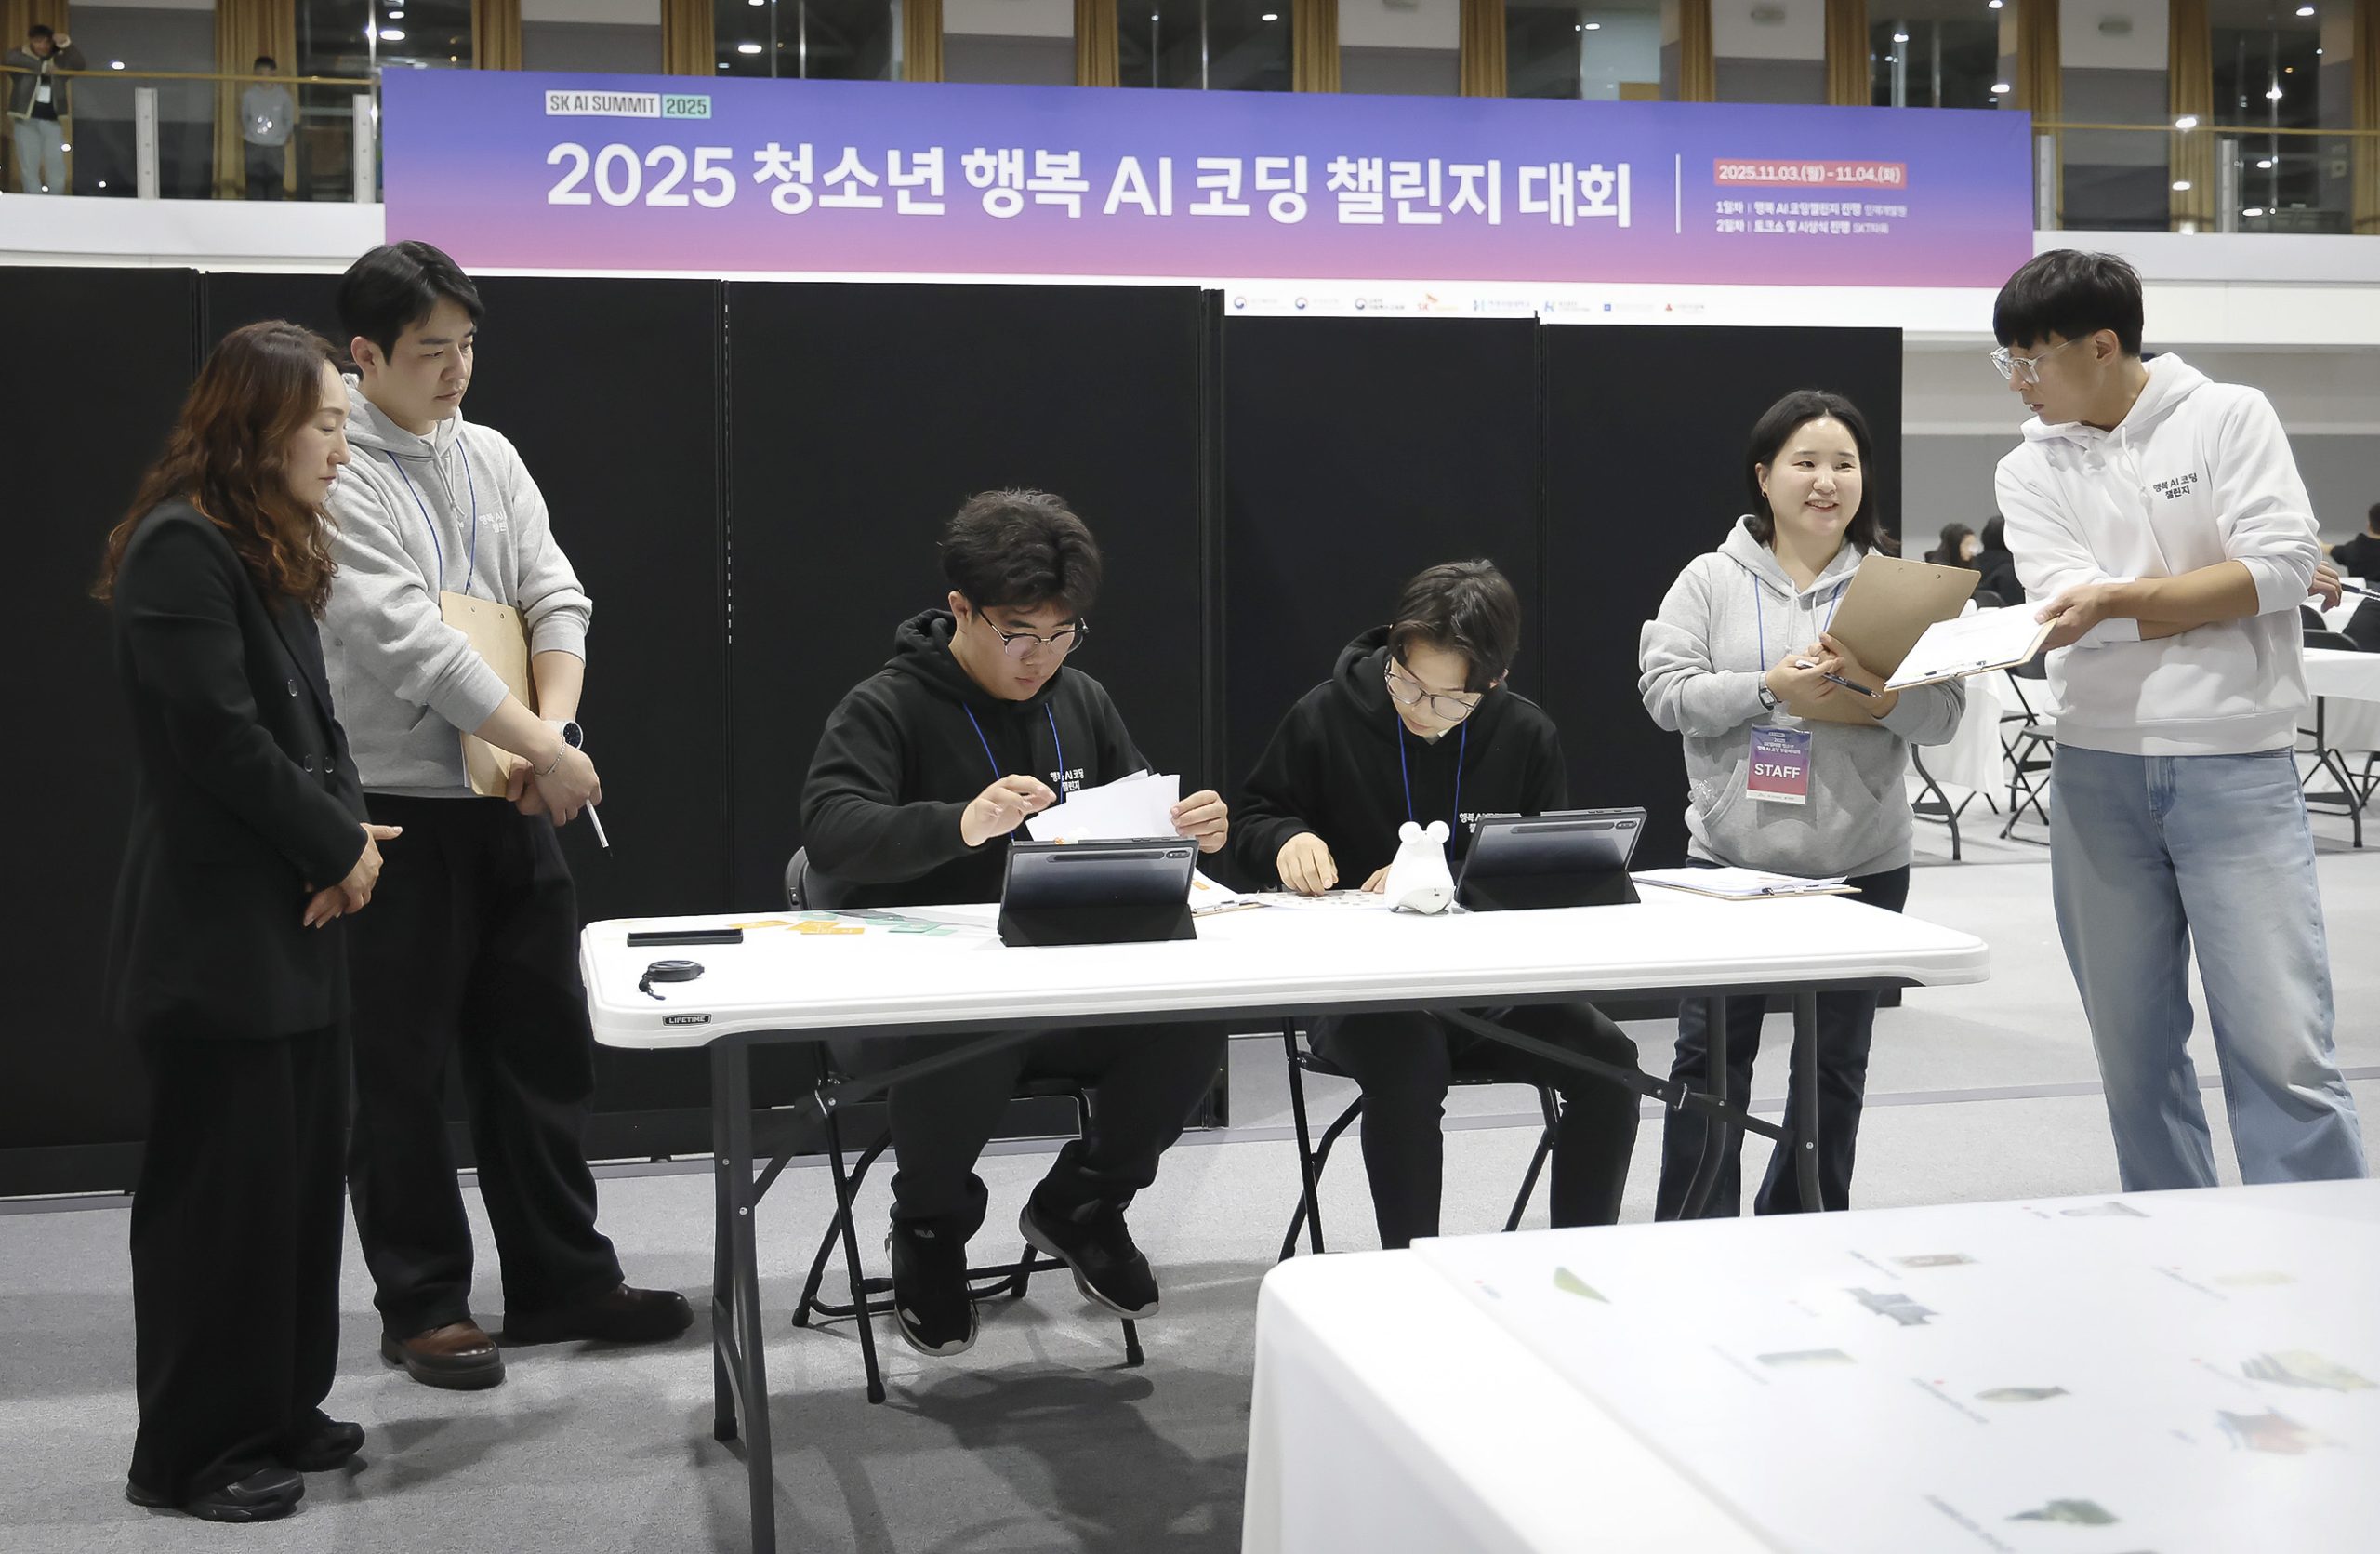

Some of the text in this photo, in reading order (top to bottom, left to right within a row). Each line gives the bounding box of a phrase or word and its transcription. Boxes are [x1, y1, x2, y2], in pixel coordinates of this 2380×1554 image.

[549, 95, 707, 115] SK AI SUMMIT 2025
[547, 141, 1632, 229] 2025 청소년 행복 AI 코딩 챌린지 대회
[2153, 472, 2198, 493] 행복 AI 코딩
[1064, 770, 1073, 780] AI
[1073, 768, 1084, 779] 코딩
[1754, 764, 1801, 779] STAFF
